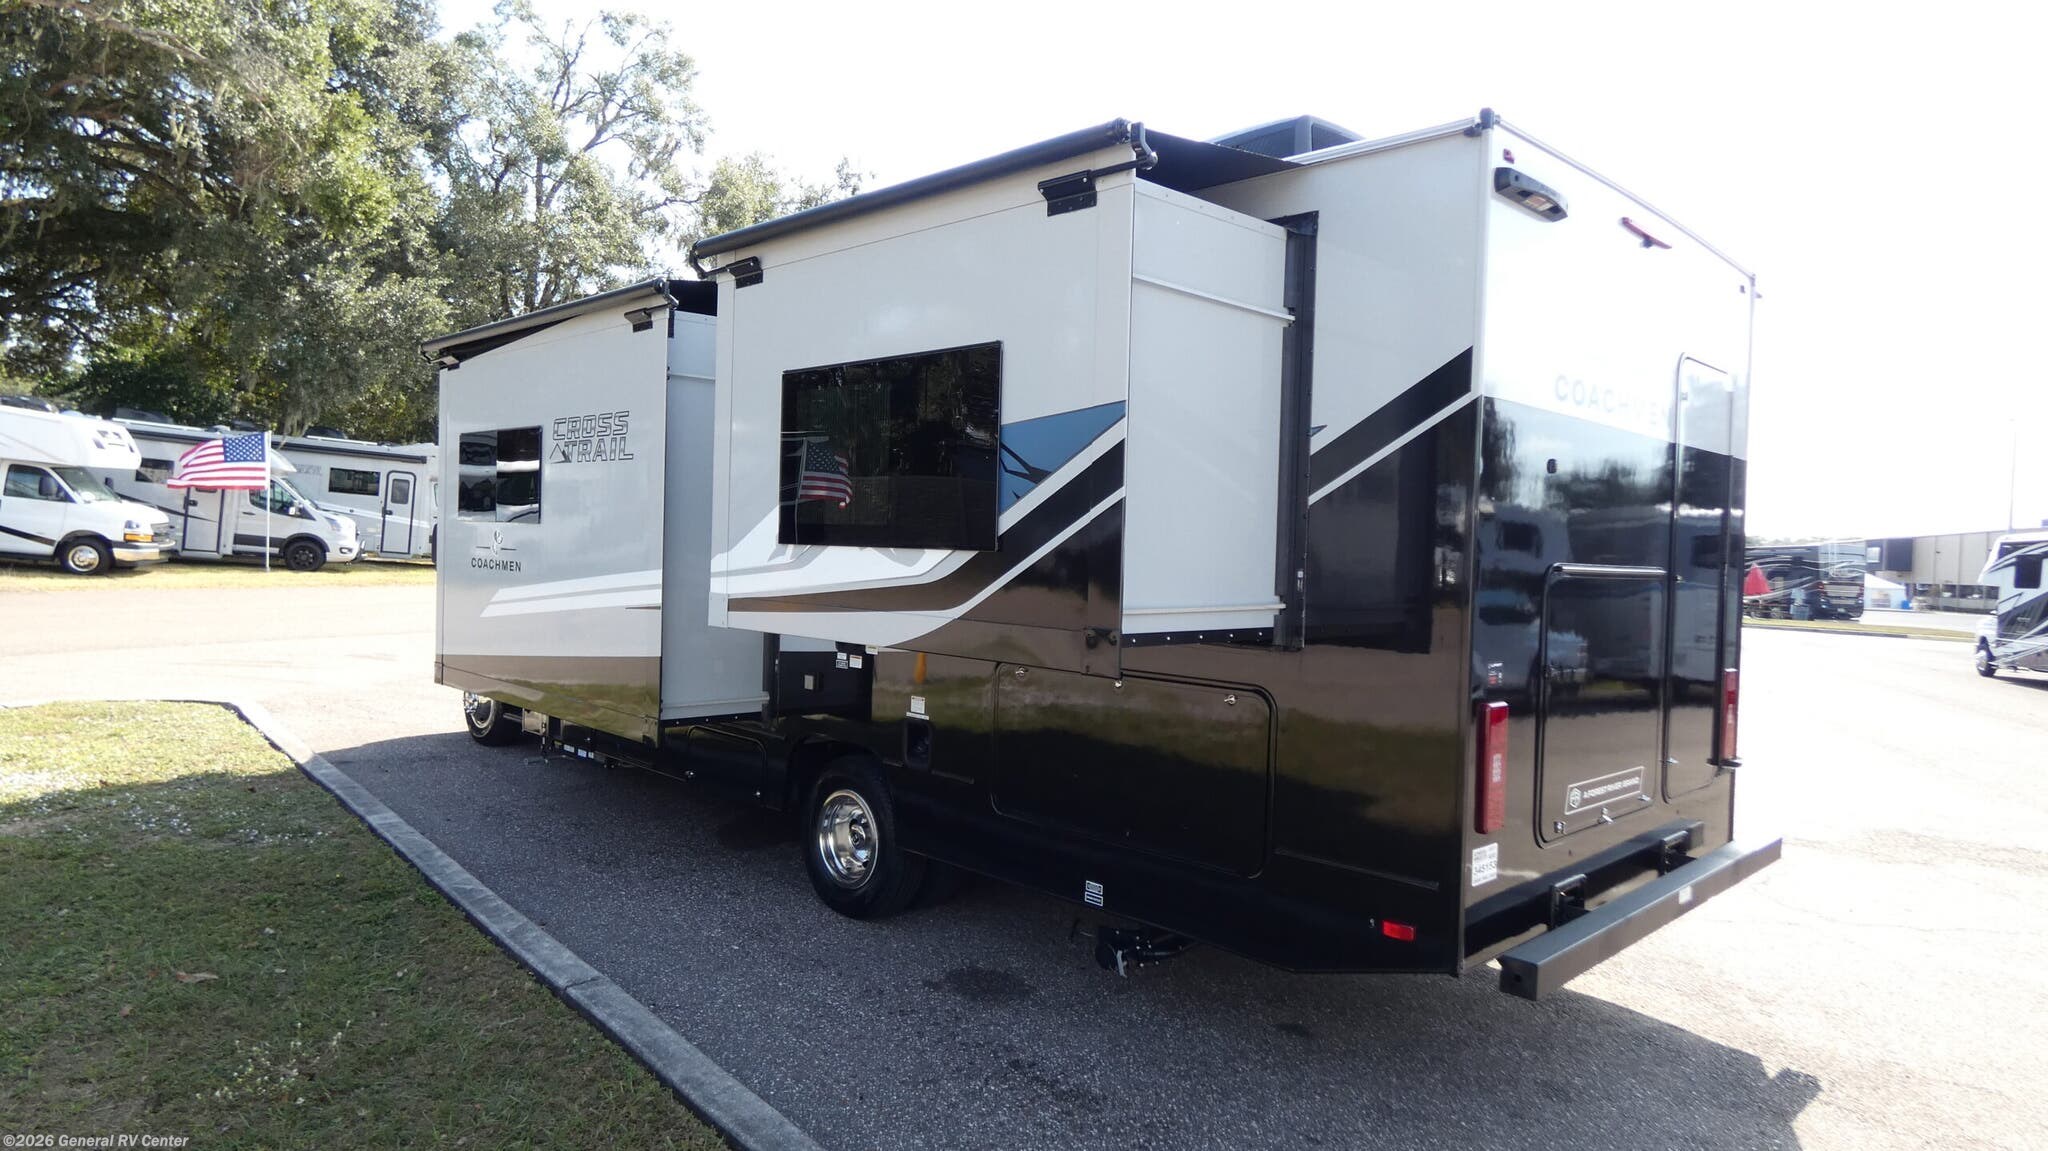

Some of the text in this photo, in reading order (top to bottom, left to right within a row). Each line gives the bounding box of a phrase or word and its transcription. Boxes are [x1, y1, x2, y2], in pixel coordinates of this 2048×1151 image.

[1555, 374, 1668, 425] COACHME
[553, 410, 630, 441] CROSS
[564, 436, 634, 463] TRAIL
[471, 557, 521, 572] COACHMEN
